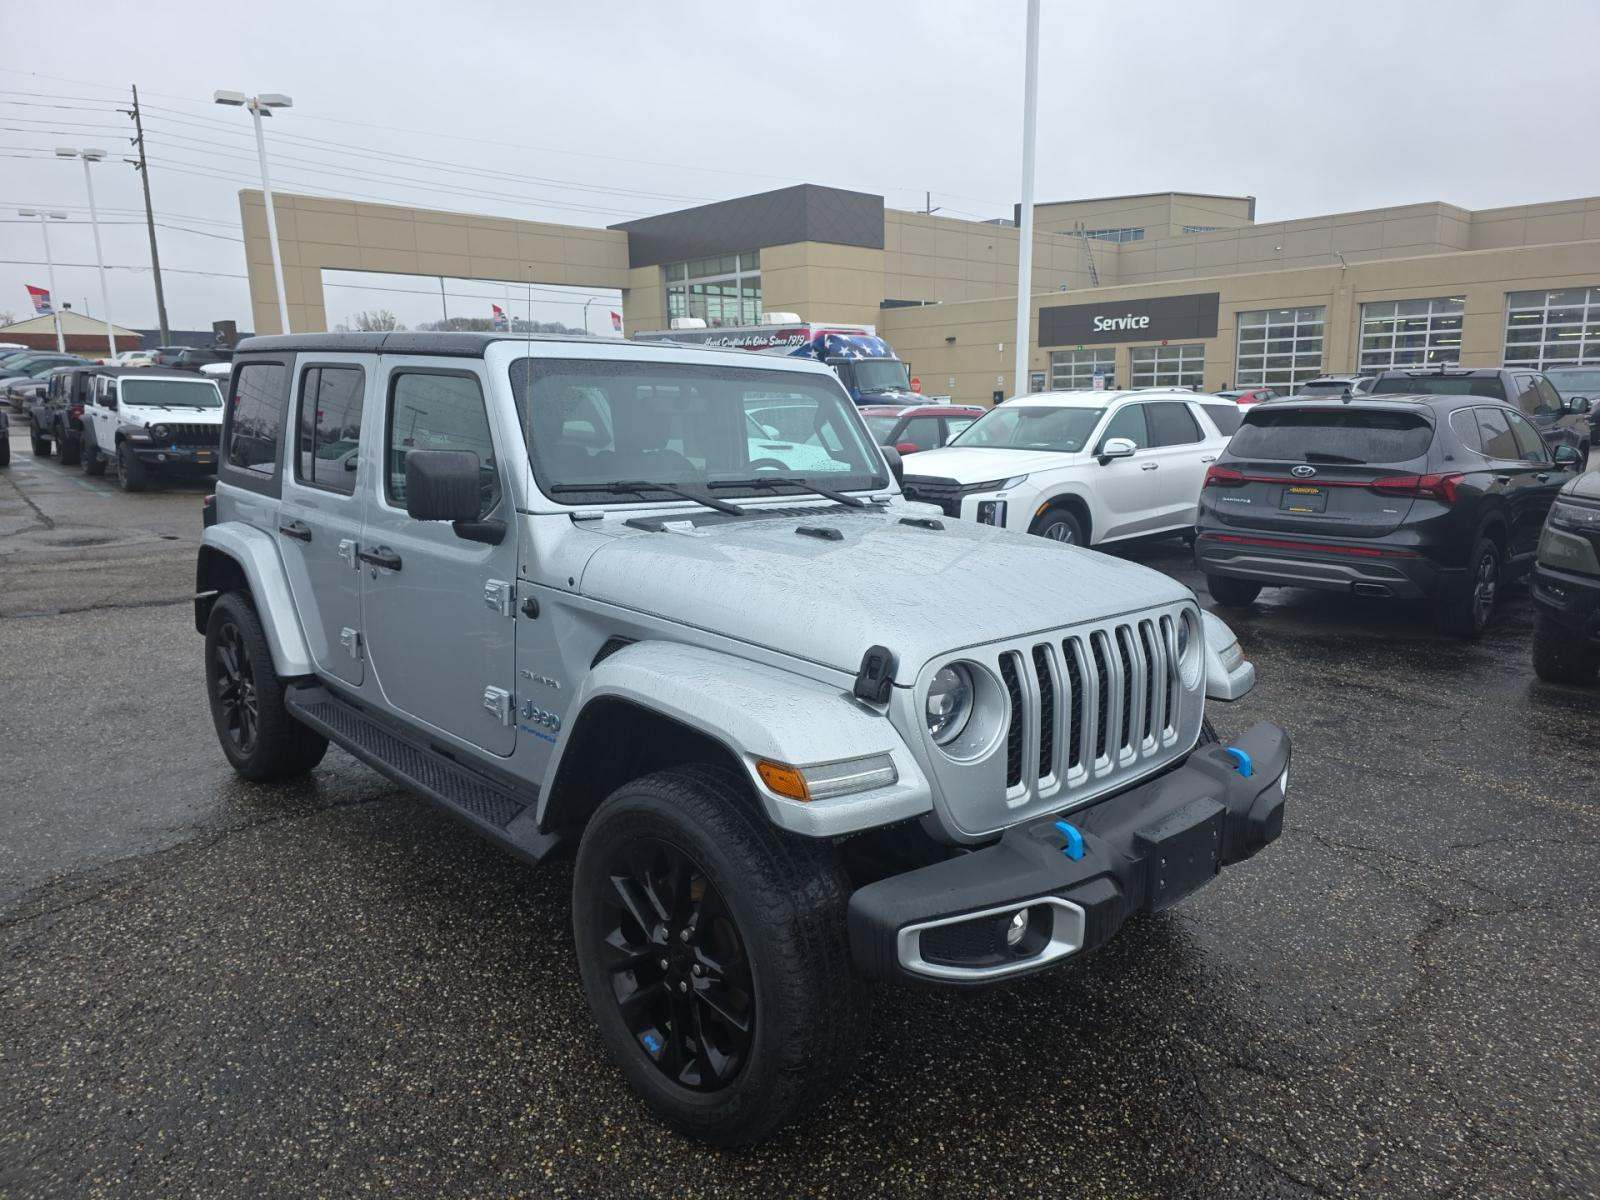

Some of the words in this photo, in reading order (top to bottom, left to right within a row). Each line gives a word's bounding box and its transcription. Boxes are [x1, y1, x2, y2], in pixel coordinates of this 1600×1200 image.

[1093, 313, 1150, 332] Service
[704, 337, 720, 347] Hand
[721, 337, 745, 346] Crafted
[753, 335, 768, 346] Ohio
[769, 335, 786, 346] Since
[786, 334, 805, 347] 1919
[520, 698, 561, 733] Jeep
